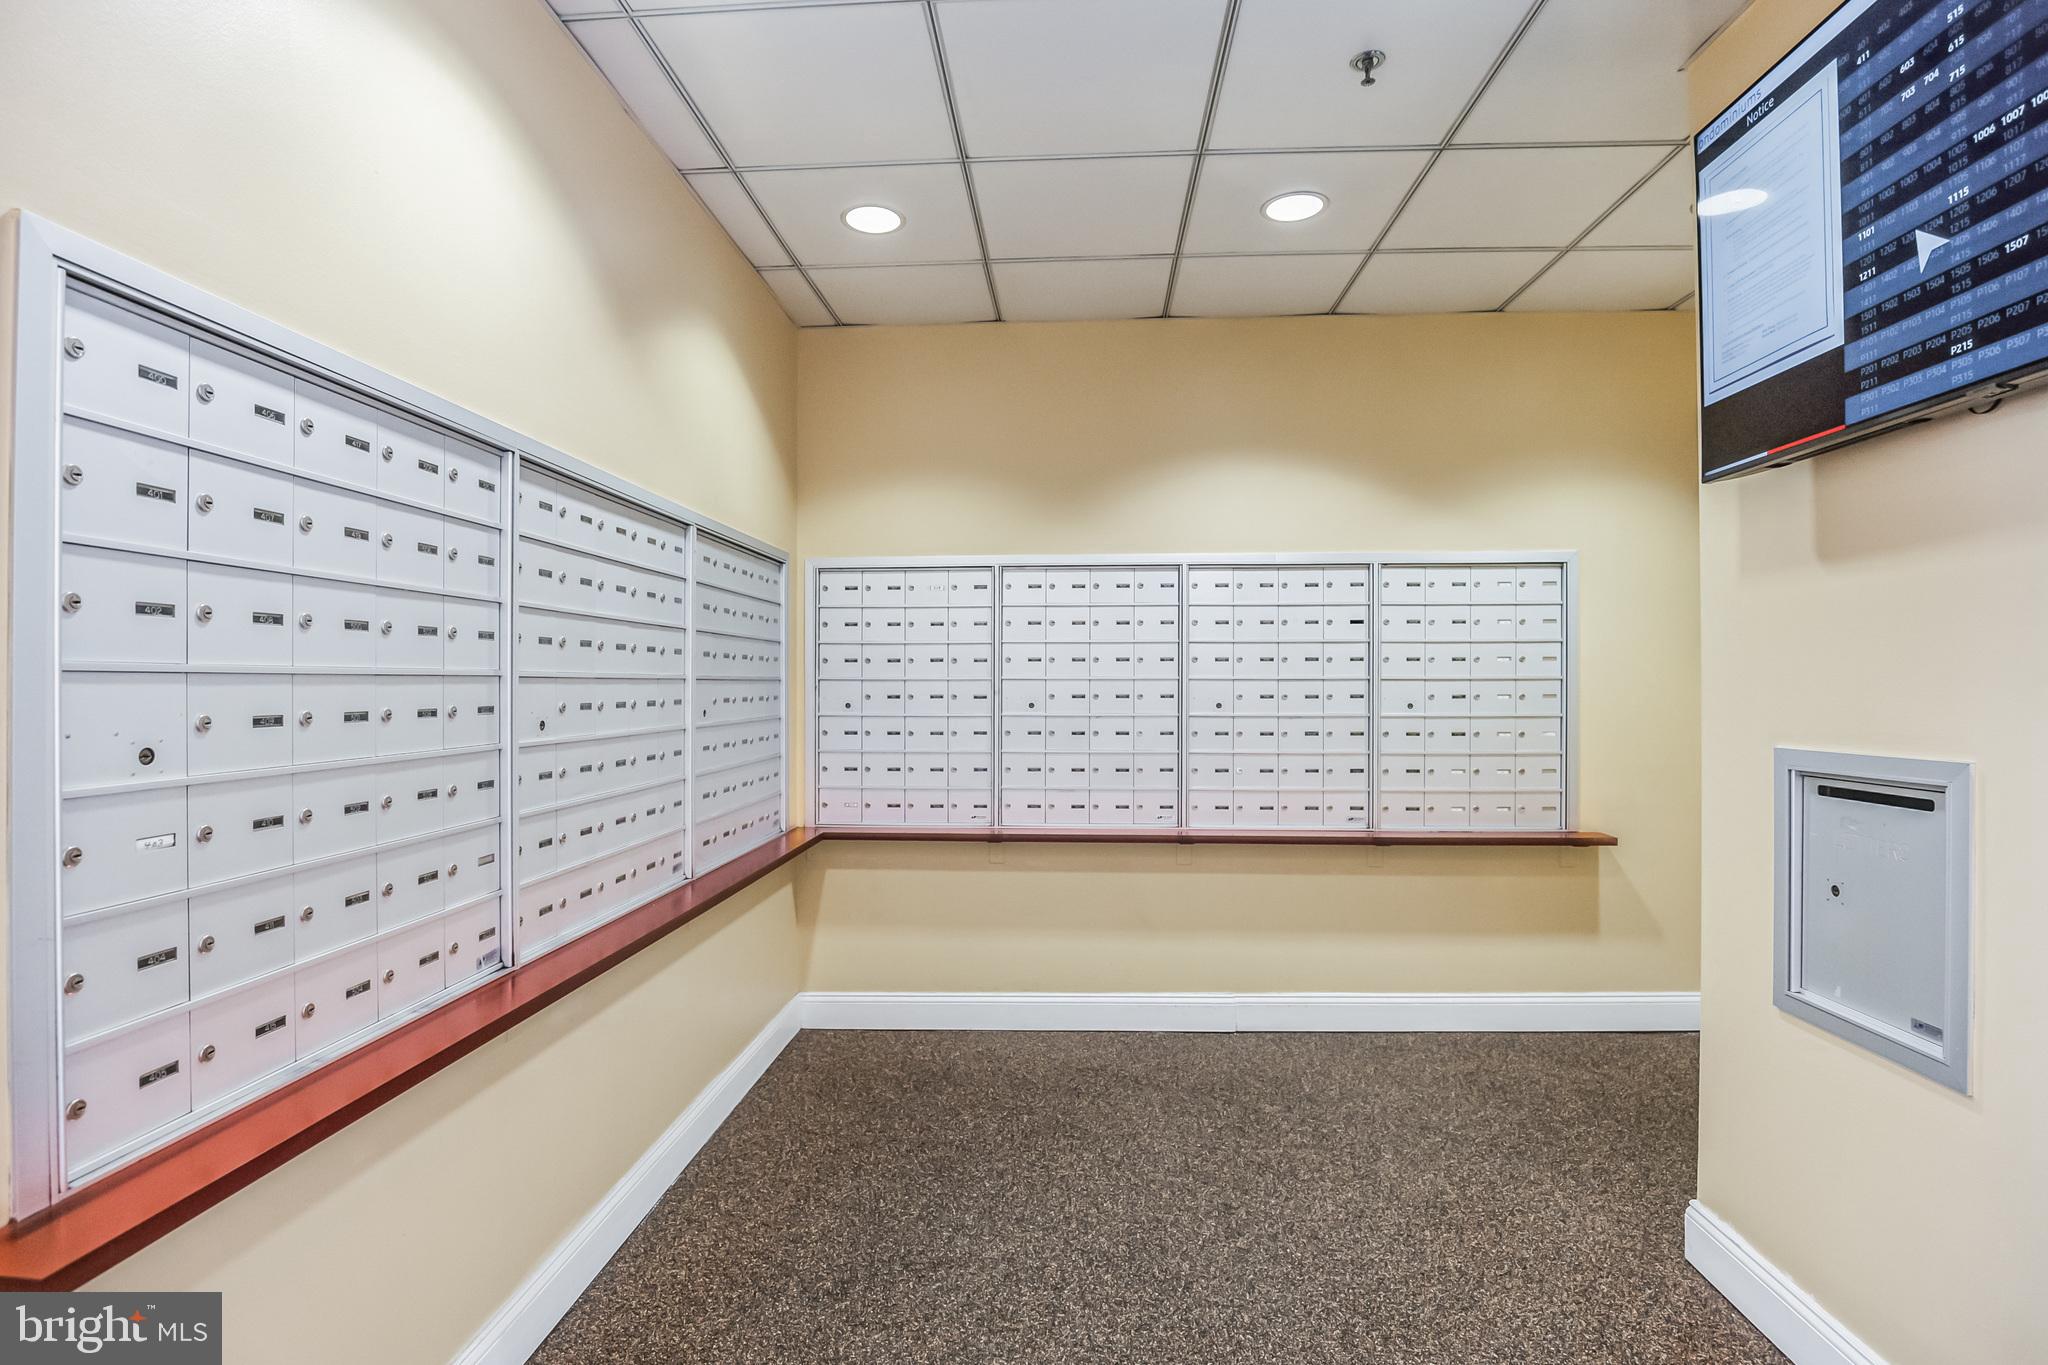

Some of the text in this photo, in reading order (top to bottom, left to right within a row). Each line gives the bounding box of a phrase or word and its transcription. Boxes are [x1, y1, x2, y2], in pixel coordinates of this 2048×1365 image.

[1857, 50, 1870, 65] 411
[1947, 4, 1964, 23] 515
[1948, 34, 1965, 52] 615
[1900, 56, 1915, 74] 603
[1949, 64, 1966, 82] 715
[1901, 85, 1915, 102] 703
[1924, 68, 1939, 86] 704
[1698, 88, 1762, 150] ondominiums
[1746, 97, 1775, 127] Notice
[2003, 120, 2025, 141] 1017
[1858, 199, 1874, 214] 1001
[1879, 185, 1896, 200] 1002
[1900, 172, 1918, 188] 1003
[1924, 157, 1942, 174] 1004
[1973, 123, 1996, 143] 1006
[2001, 104, 2025, 126] 1007
[2031, 90, 2048, 107] 100
[1858, 226, 1874, 241] 1101
[1976, 156, 1997, 174] 1106
[2004, 137, 2025, 157] 1107
[1948, 186, 1969, 204] 1115
[2004, 153, 2026, 172] 1117
[1880, 242, 1897, 256] 1202
[1902, 232, 1916, 245] 120
[1949, 203, 1969, 218] 1205
[1976, 187, 1997, 204] 1206
[2004, 170, 2027, 189] 1207
[1977, 221, 1998, 235] 1406
[1859, 218, 1970, 282] 1211 1215
[1861, 308, 1877, 322] 1501
[1881, 298, 1898, 312] 1502
[1903, 287, 1921, 302] 1503
[1926, 278, 1945, 290] 1504
[1951, 263, 1971, 278] 1505
[1977, 250, 1999, 267] 1506
[2004, 234, 2029, 253] 1507
[1926, 305, 1945, 320] P104
[1977, 284, 2000, 297] P106
[2006, 268, 2029, 284] P107
[1861, 280, 1972, 336] 1511 1515
[1951, 309, 1972, 324] P115
[1861, 363, 1877, 376] P201
[1881, 354, 1899, 368] P202
[1903, 345, 1922, 359] P203
[1926, 335, 1946, 350] P204
[1951, 324, 1973, 340] P205
[1977, 313, 2000, 329] P206
[2006, 300, 2030, 317] P207
[148, 371, 166, 385] 400
[1861, 339, 1973, 390] P211 P215
[148, 489, 163, 500] 401
[260, 512, 275, 522] 407
[144, 606, 162, 616] 402
[259, 615, 274, 624] 408
[148, 953, 165, 964] 404
